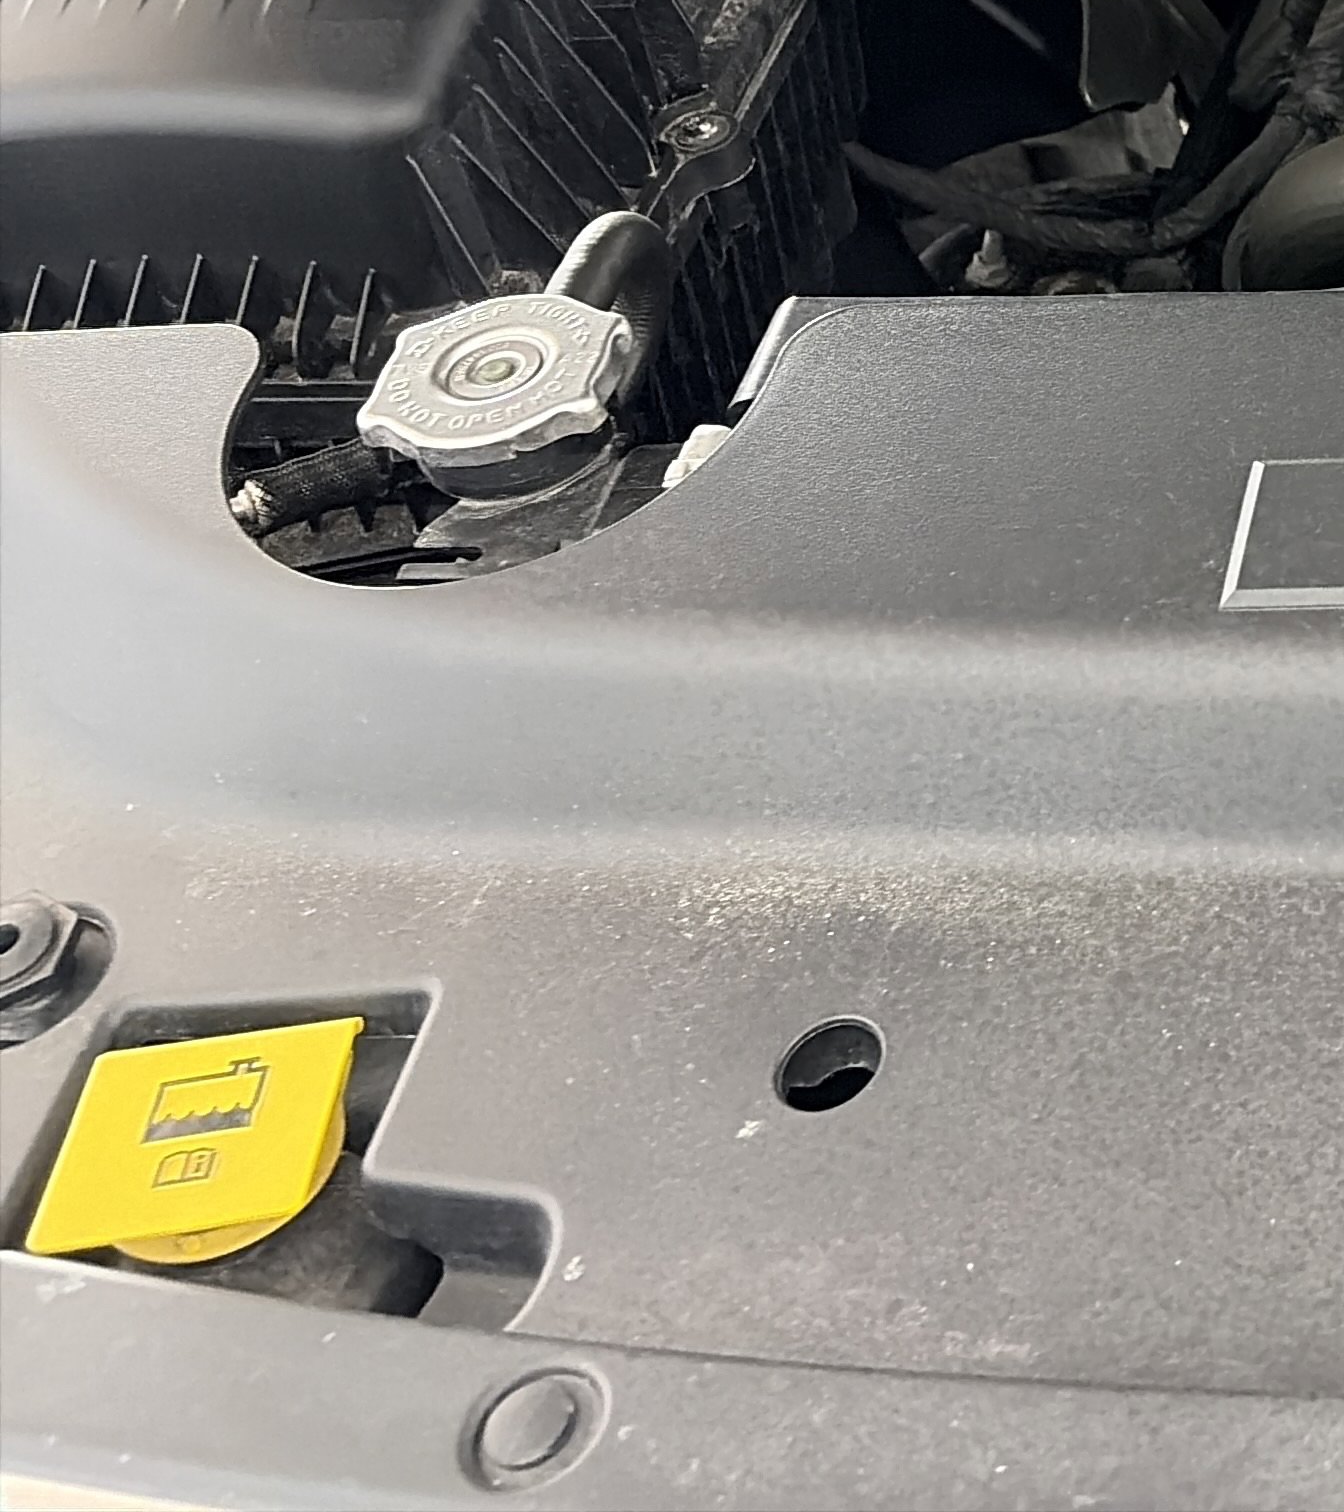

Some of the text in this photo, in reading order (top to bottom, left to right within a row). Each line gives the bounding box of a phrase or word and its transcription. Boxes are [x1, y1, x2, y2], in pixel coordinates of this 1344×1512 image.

[432, 303, 513, 339] KEEP
[387, 377, 411, 403] DO
[398, 400, 450, 428] NOT
[447, 402, 523, 430] OPEN
